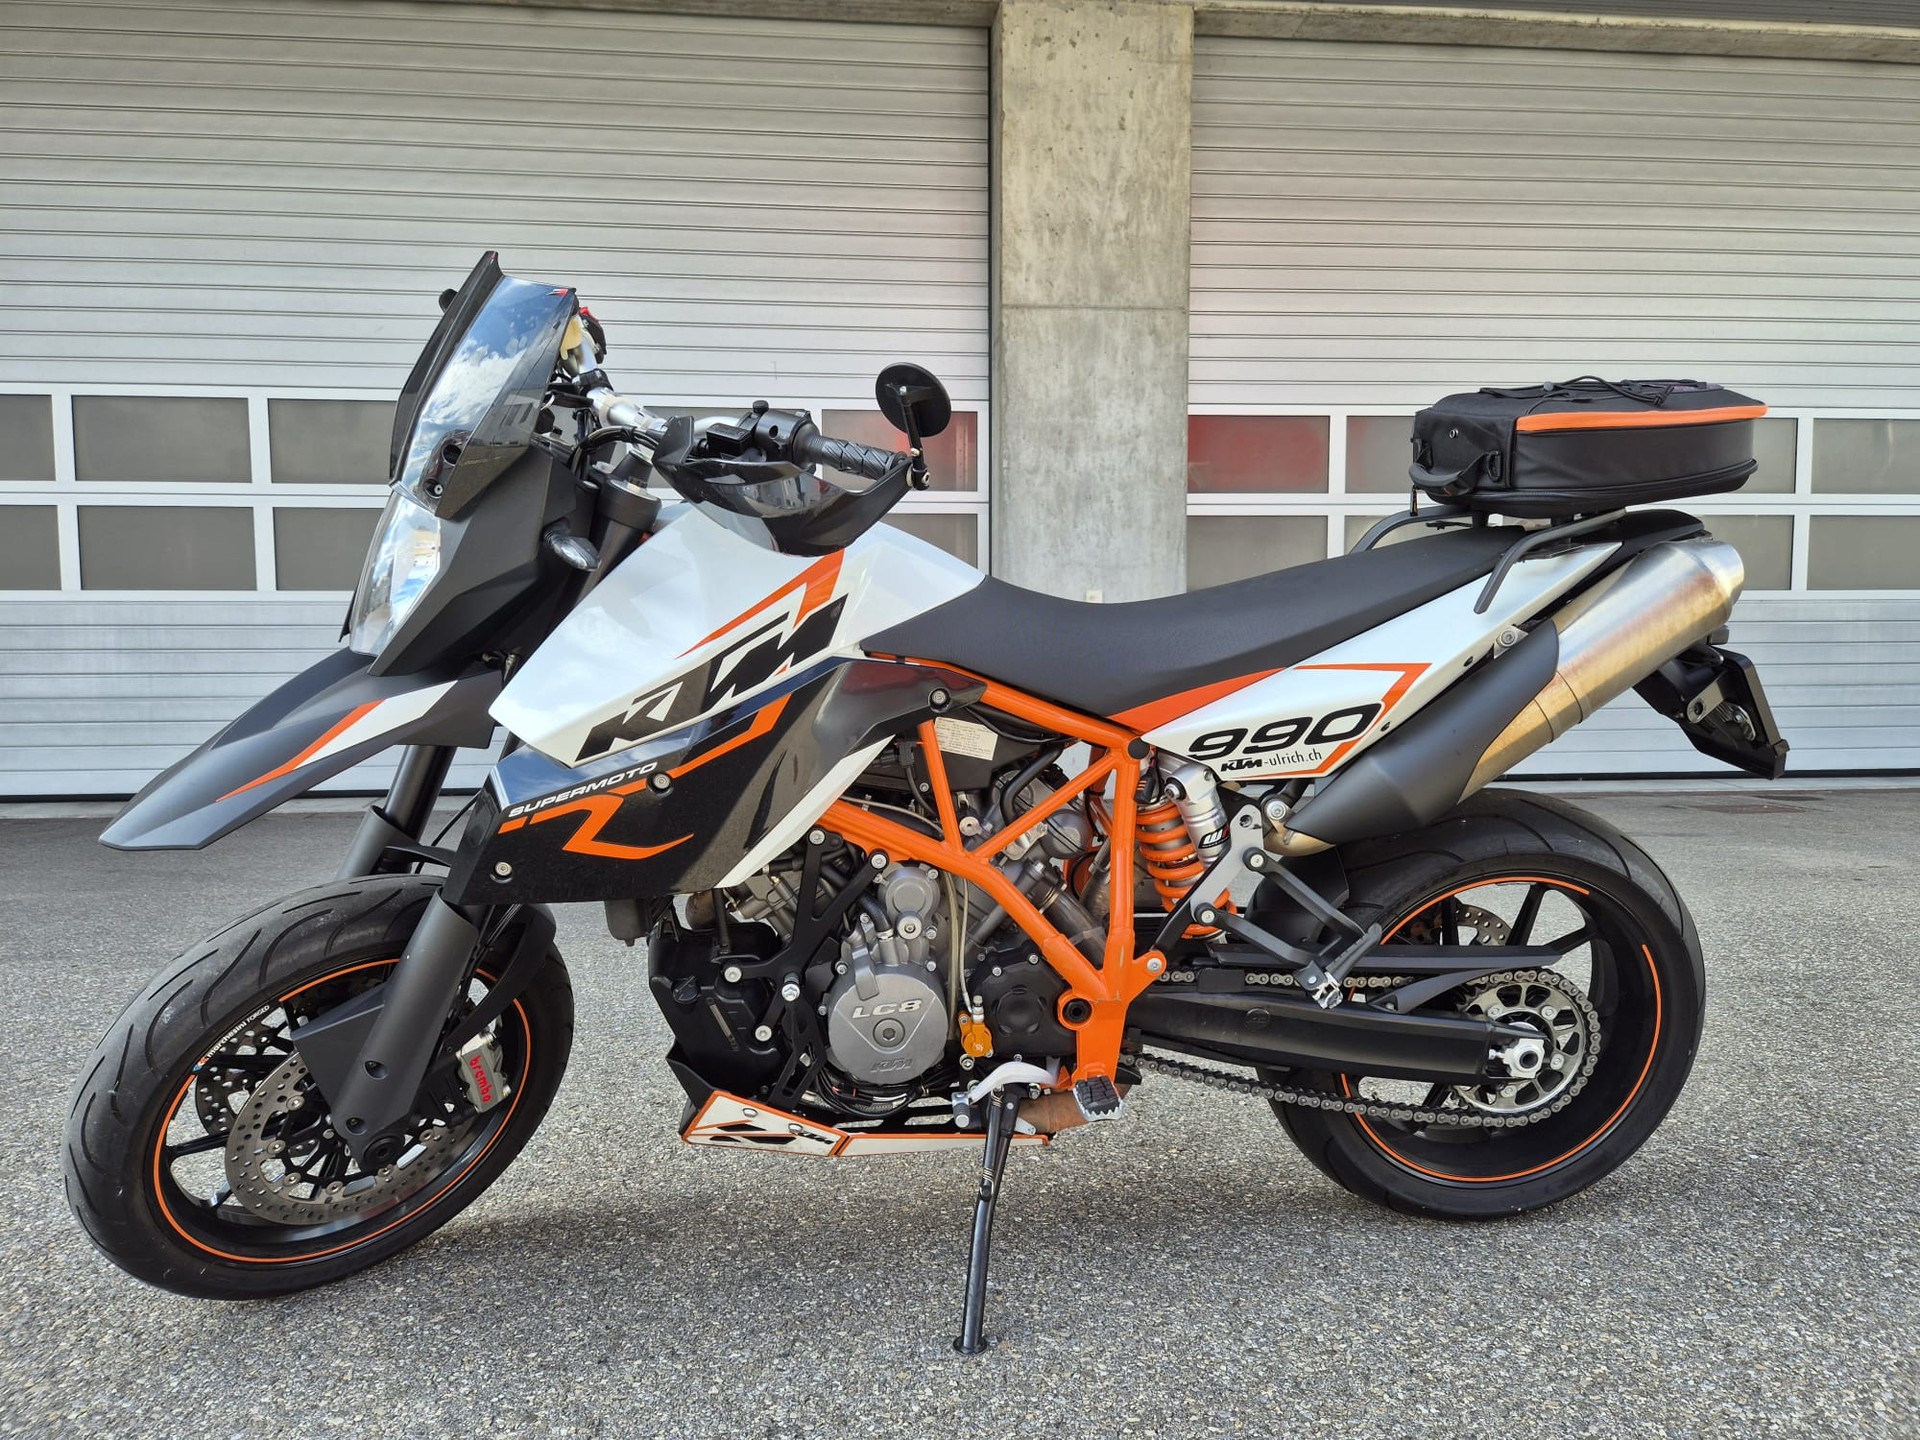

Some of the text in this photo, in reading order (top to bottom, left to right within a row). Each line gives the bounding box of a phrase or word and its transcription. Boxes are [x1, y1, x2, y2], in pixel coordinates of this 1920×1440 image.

[575, 593, 848, 762] KTM
[1188, 703, 1382, 760] 990
[508, 762, 657, 817] SUPERMOTO
[852, 999, 922, 1019] LC8
[469, 1054, 493, 1103] brembo
[870, 1057, 913, 1074] KTM
